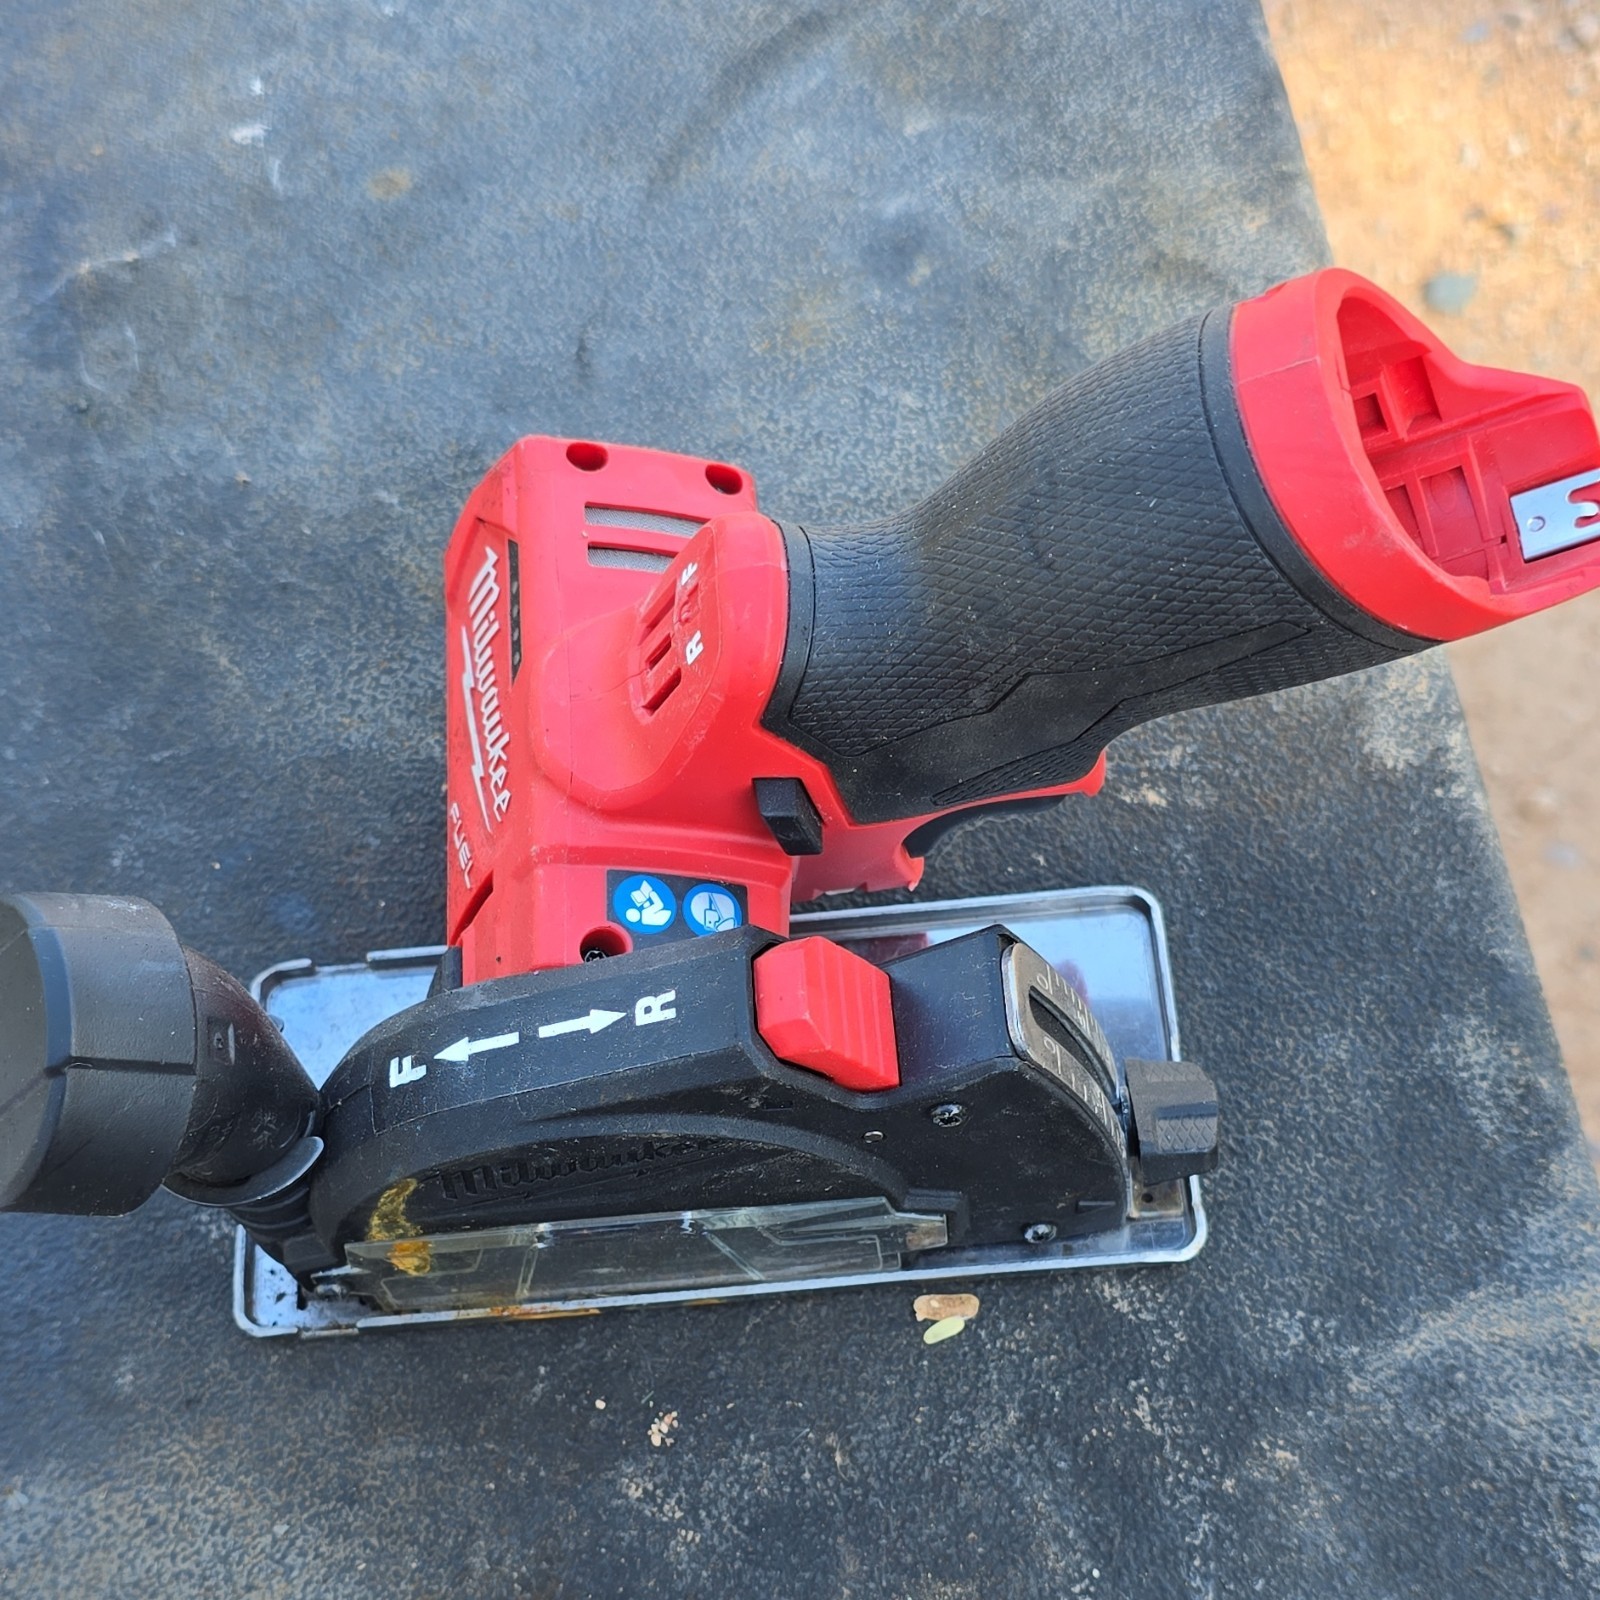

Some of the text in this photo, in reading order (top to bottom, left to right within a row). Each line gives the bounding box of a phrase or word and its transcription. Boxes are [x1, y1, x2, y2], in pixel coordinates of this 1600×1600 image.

[681, 562, 698, 587] F
[685, 629, 704, 666] R
[468, 546, 511, 822] Milwaukee
[450, 802, 474, 889] FUEL
[634, 989, 677, 1027] R
[389, 1055, 427, 1089] F
